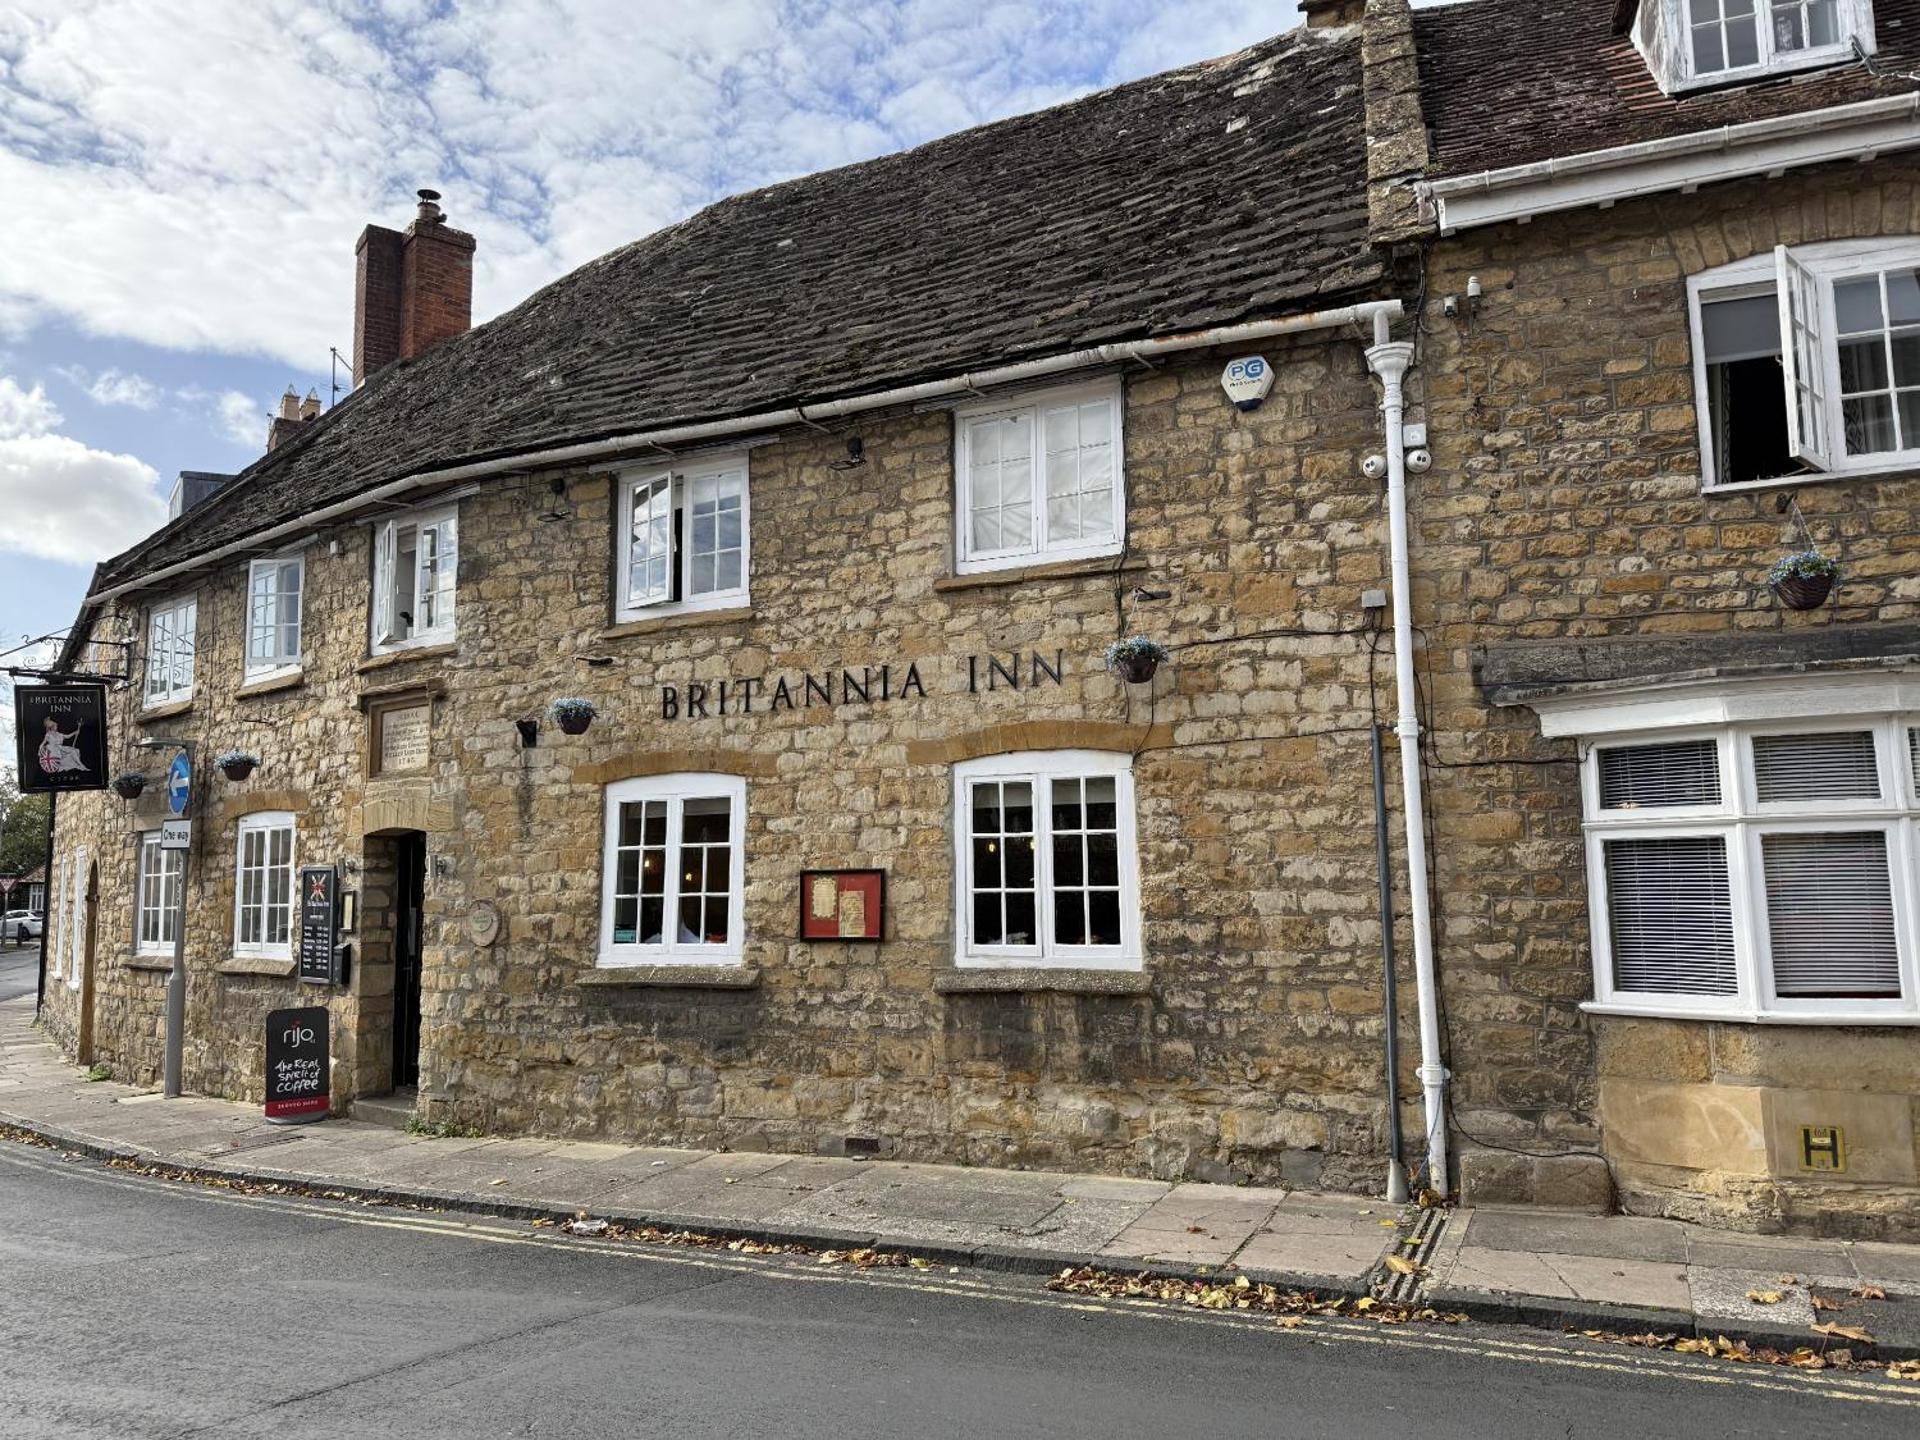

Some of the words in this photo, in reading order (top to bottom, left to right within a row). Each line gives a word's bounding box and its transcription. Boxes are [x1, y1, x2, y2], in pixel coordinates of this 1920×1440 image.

[1227, 360, 1264, 380] PG
[662, 662, 928, 719] BRITANNIA
[967, 648, 1063, 693] INN
[35, 695, 92, 704] BRITANNIA
[50, 704, 72, 713] INN
[164, 829, 176, 840] One
[177, 831, 188, 842] way
[1803, 1129, 1839, 1168] H
